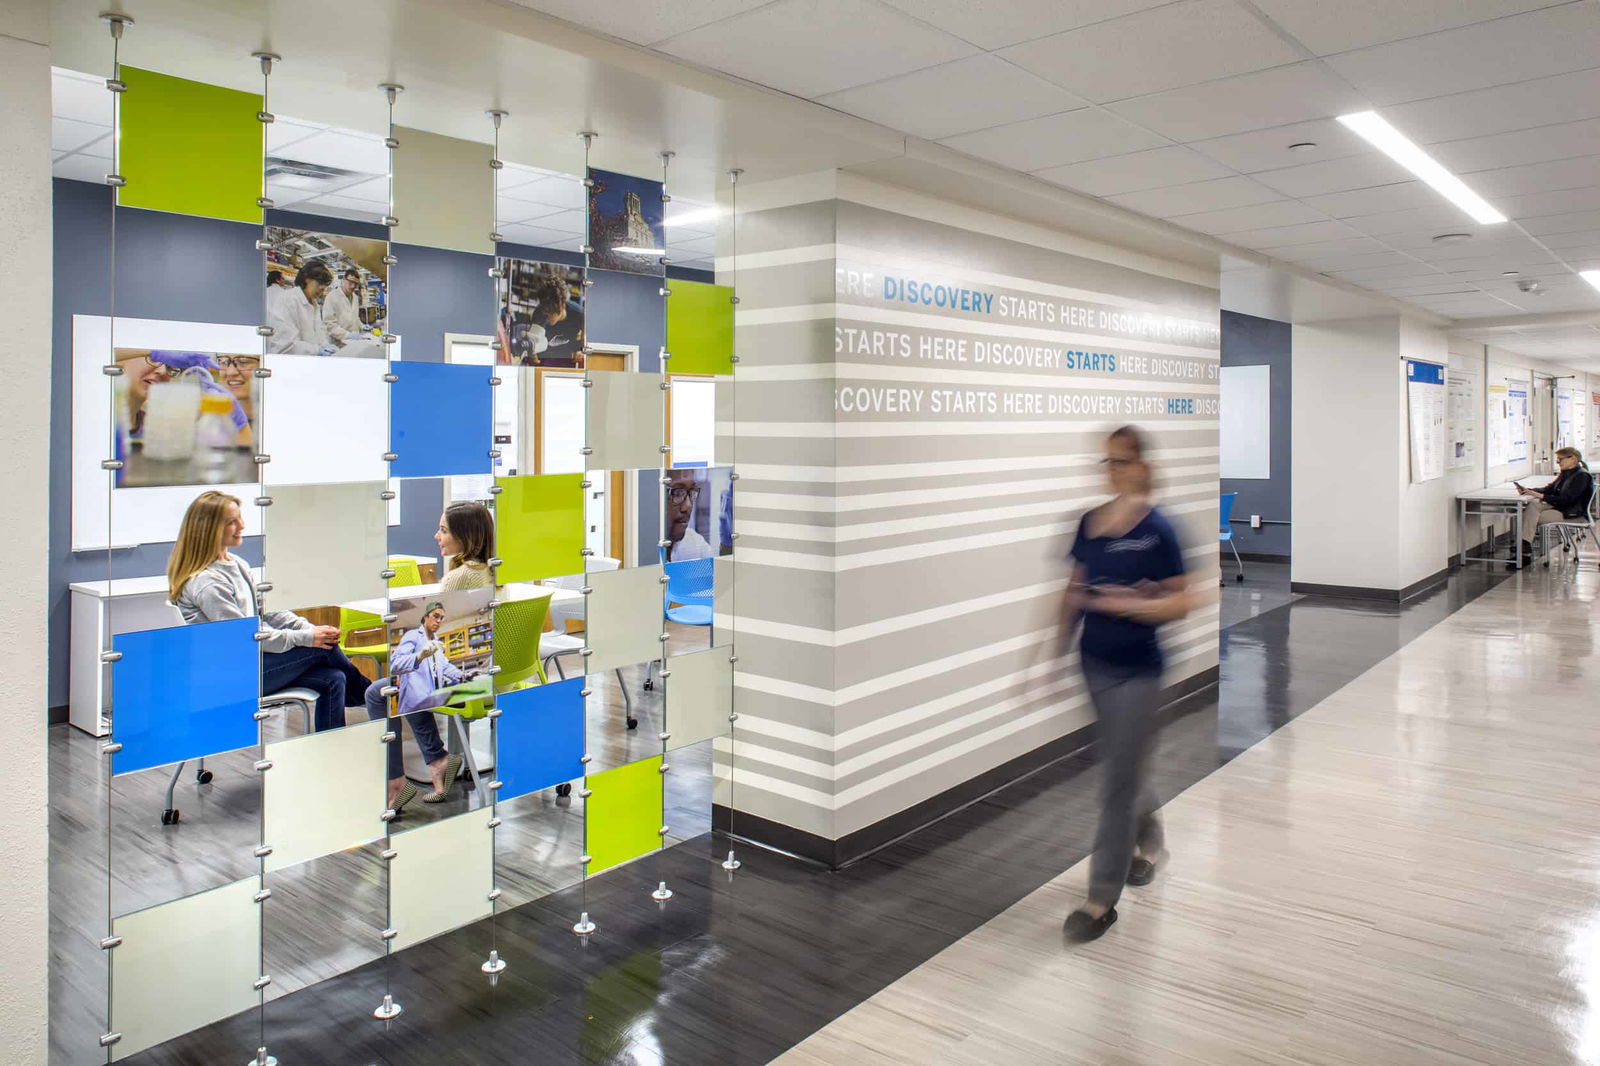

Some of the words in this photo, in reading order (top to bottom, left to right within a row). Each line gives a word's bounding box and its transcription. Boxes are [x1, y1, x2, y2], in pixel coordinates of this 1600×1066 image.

[884, 276, 994, 314] DISCOVERY
[999, 295, 1055, 322] STARTS
[1060, 305, 1095, 328] HERE
[835, 327, 911, 357] STARTS
[919, 336, 968, 362] HERE
[974, 341, 1062, 369] DISCOVERY
[1066, 351, 1116, 372] STARTS
[1119, 355, 1148, 374] HERE
[1151, 358, 1205, 379] DISCOVERY
[1208, 364, 1220, 380] ST
[835, 387, 924, 412] COVERY
[930, 390, 998, 413] STARTS
[1003, 393, 1043, 413] HERE
[1048, 394, 1121, 414] DISCOVERY
[1125, 396, 1164, 414] STARTS
[1167, 398, 1193, 414] HERE
